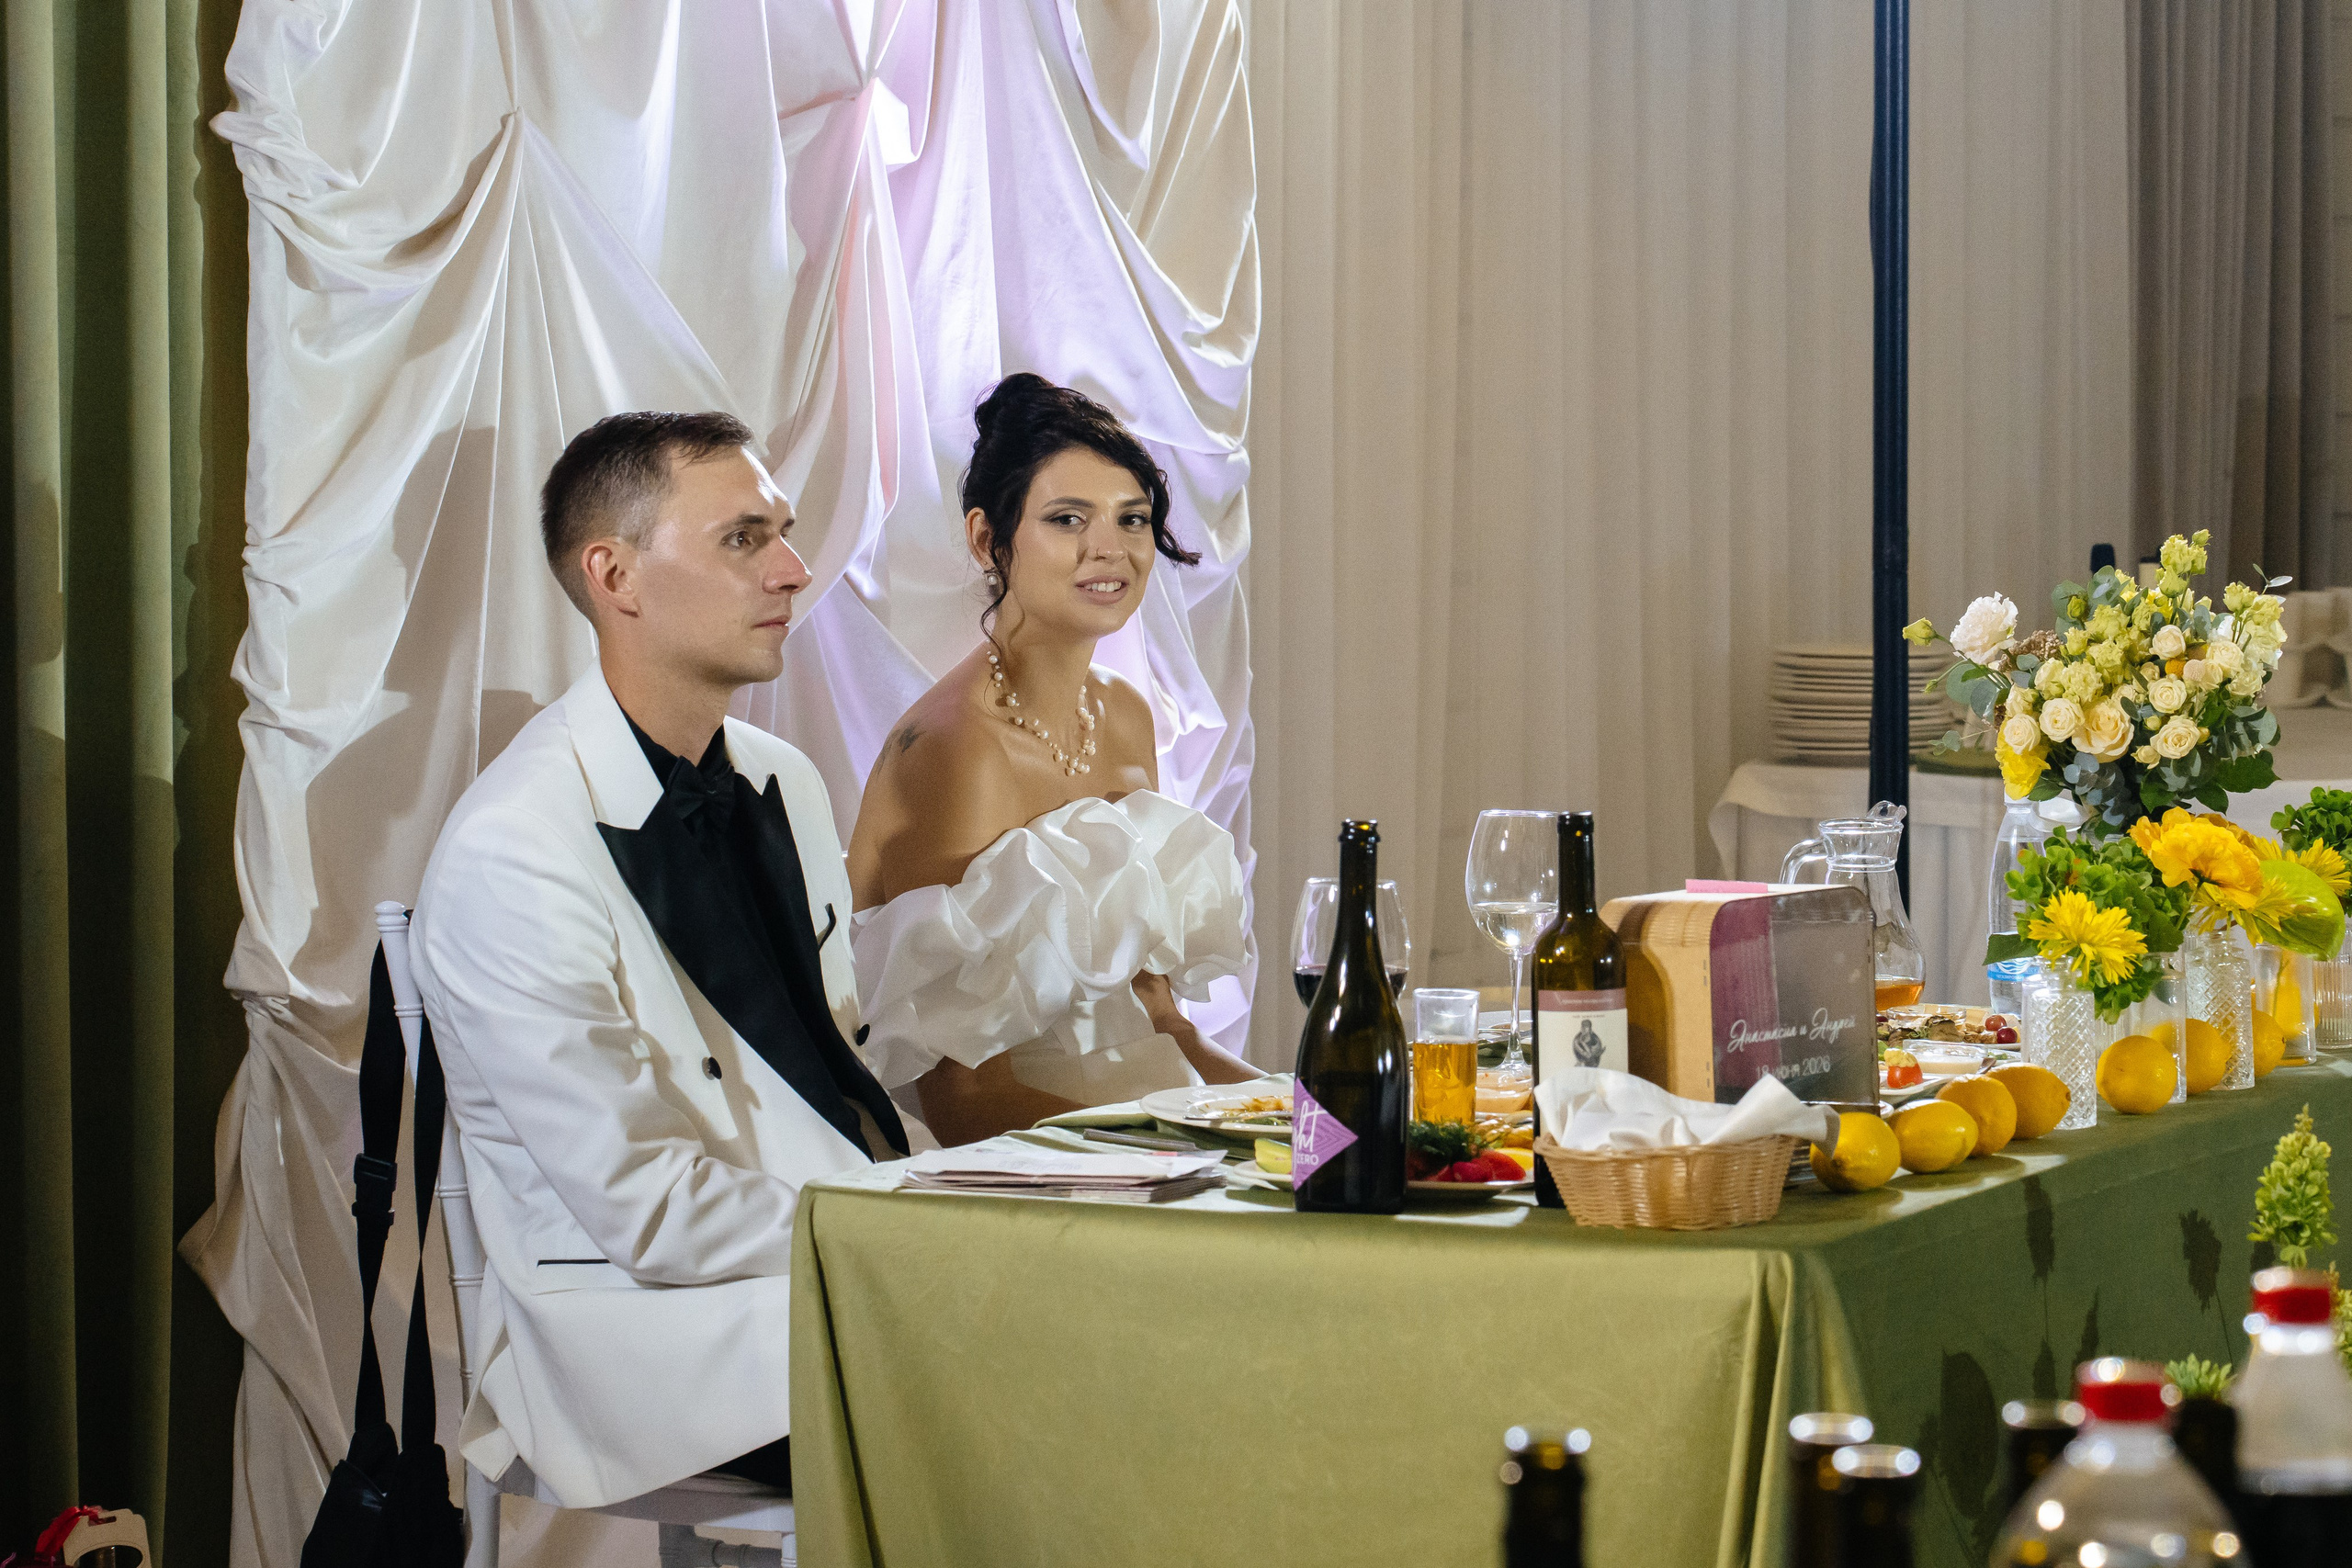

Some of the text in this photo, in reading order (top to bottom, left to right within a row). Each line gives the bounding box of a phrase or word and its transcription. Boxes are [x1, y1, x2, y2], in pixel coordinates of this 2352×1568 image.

[1800, 1025, 1807, 1036] и
[1810, 1008, 1856, 1043] Андрей
[1802, 1055, 1831, 1077] 2026
[1296, 1154, 1319, 1166] ZERO
